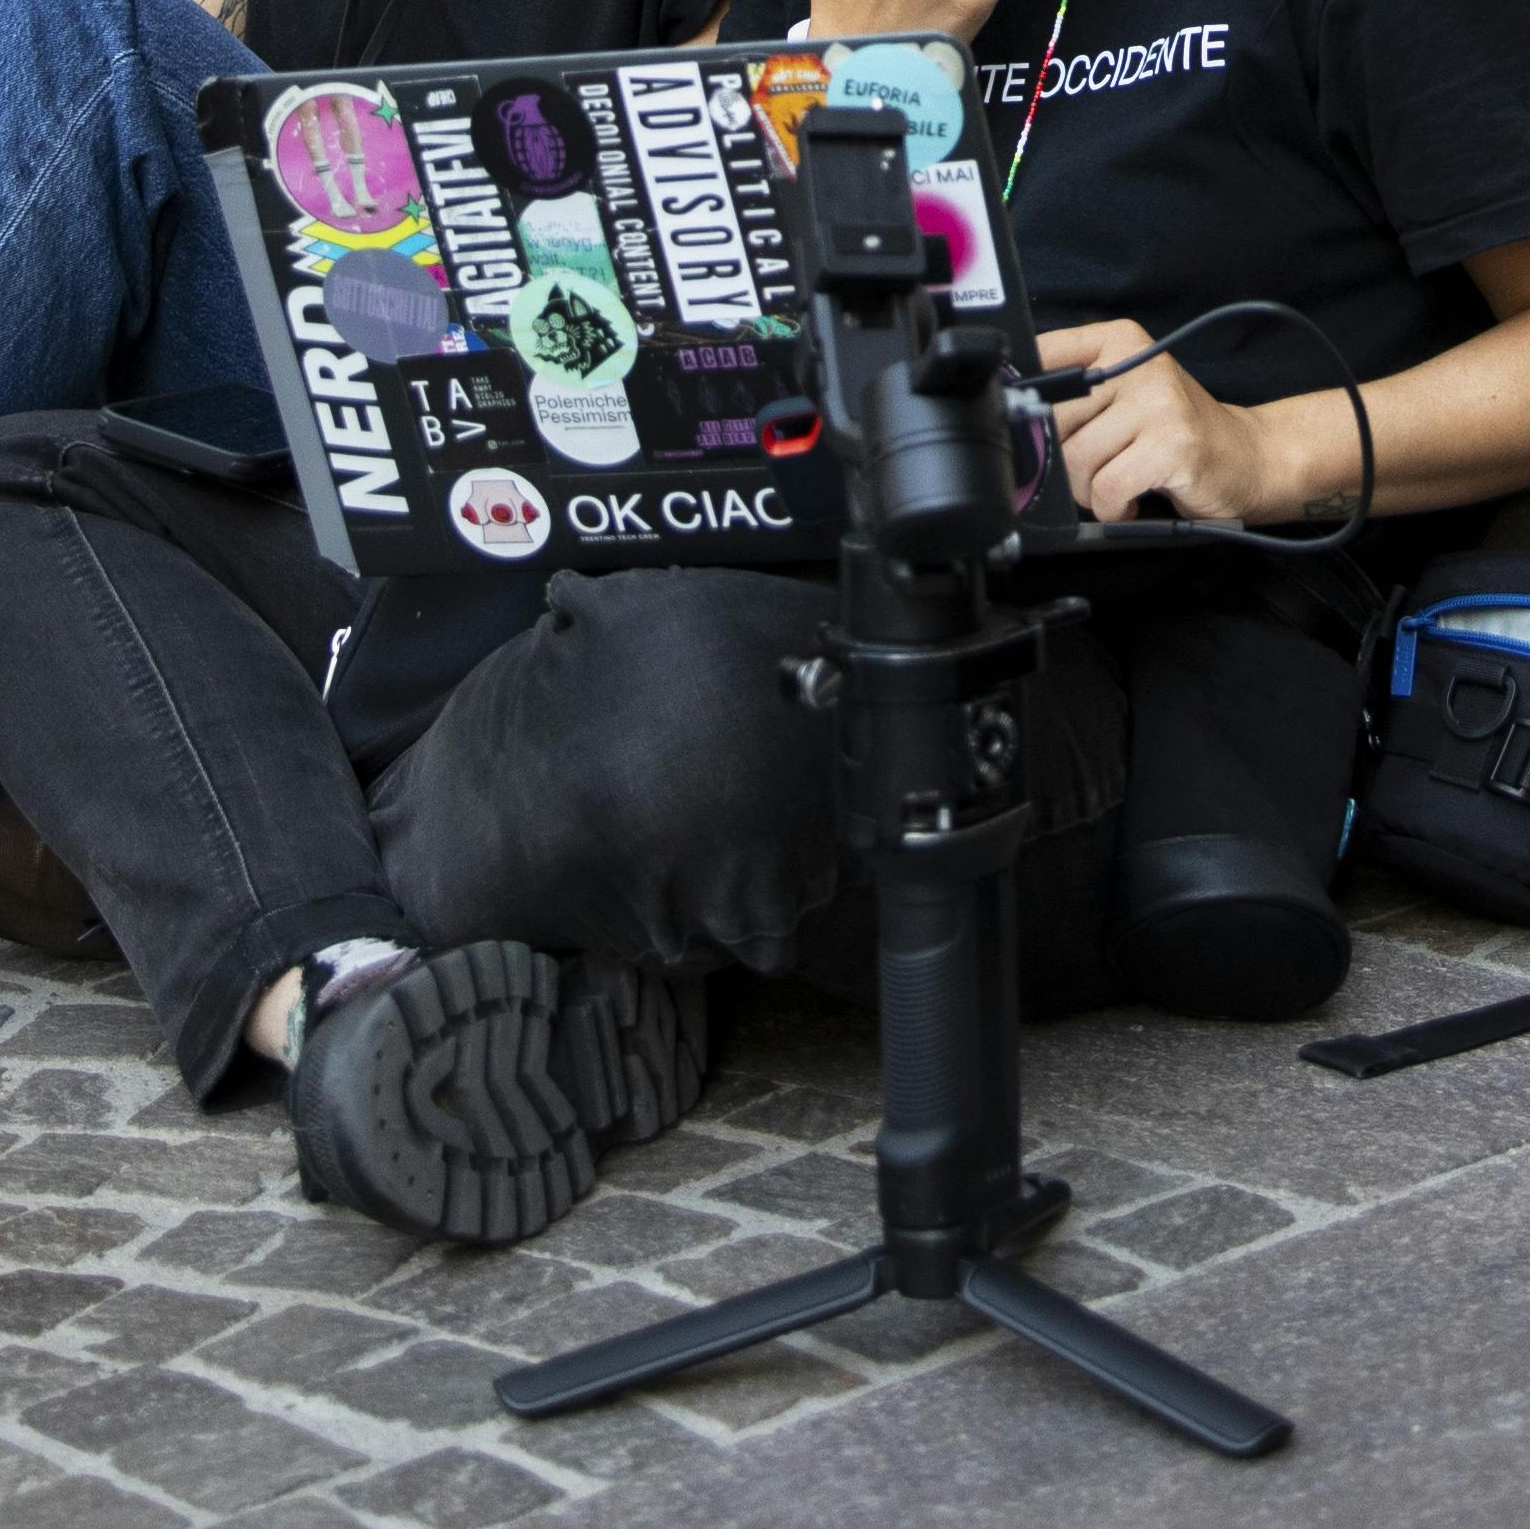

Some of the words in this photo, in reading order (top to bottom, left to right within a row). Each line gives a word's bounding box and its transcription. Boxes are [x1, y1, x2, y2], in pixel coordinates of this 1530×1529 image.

[973, 62, 1029, 104] TE
[1040, 24, 1229, 98] OCCIDENTE
[844, 79, 921, 106] EUFORIA
[907, 120, 948, 138] BILE
[629, 77, 753, 307] ADVISORY
[708, 73, 796, 300] PLITICAL
[935, 166, 975, 184] MAI
[413, 117, 524, 316] AGITATEVI
[615, 218, 666, 309] CONTENT
[951, 289, 1000, 302] MPRE
[535, 394, 627, 409] Polemiche
[567, 493, 653, 533] OK
